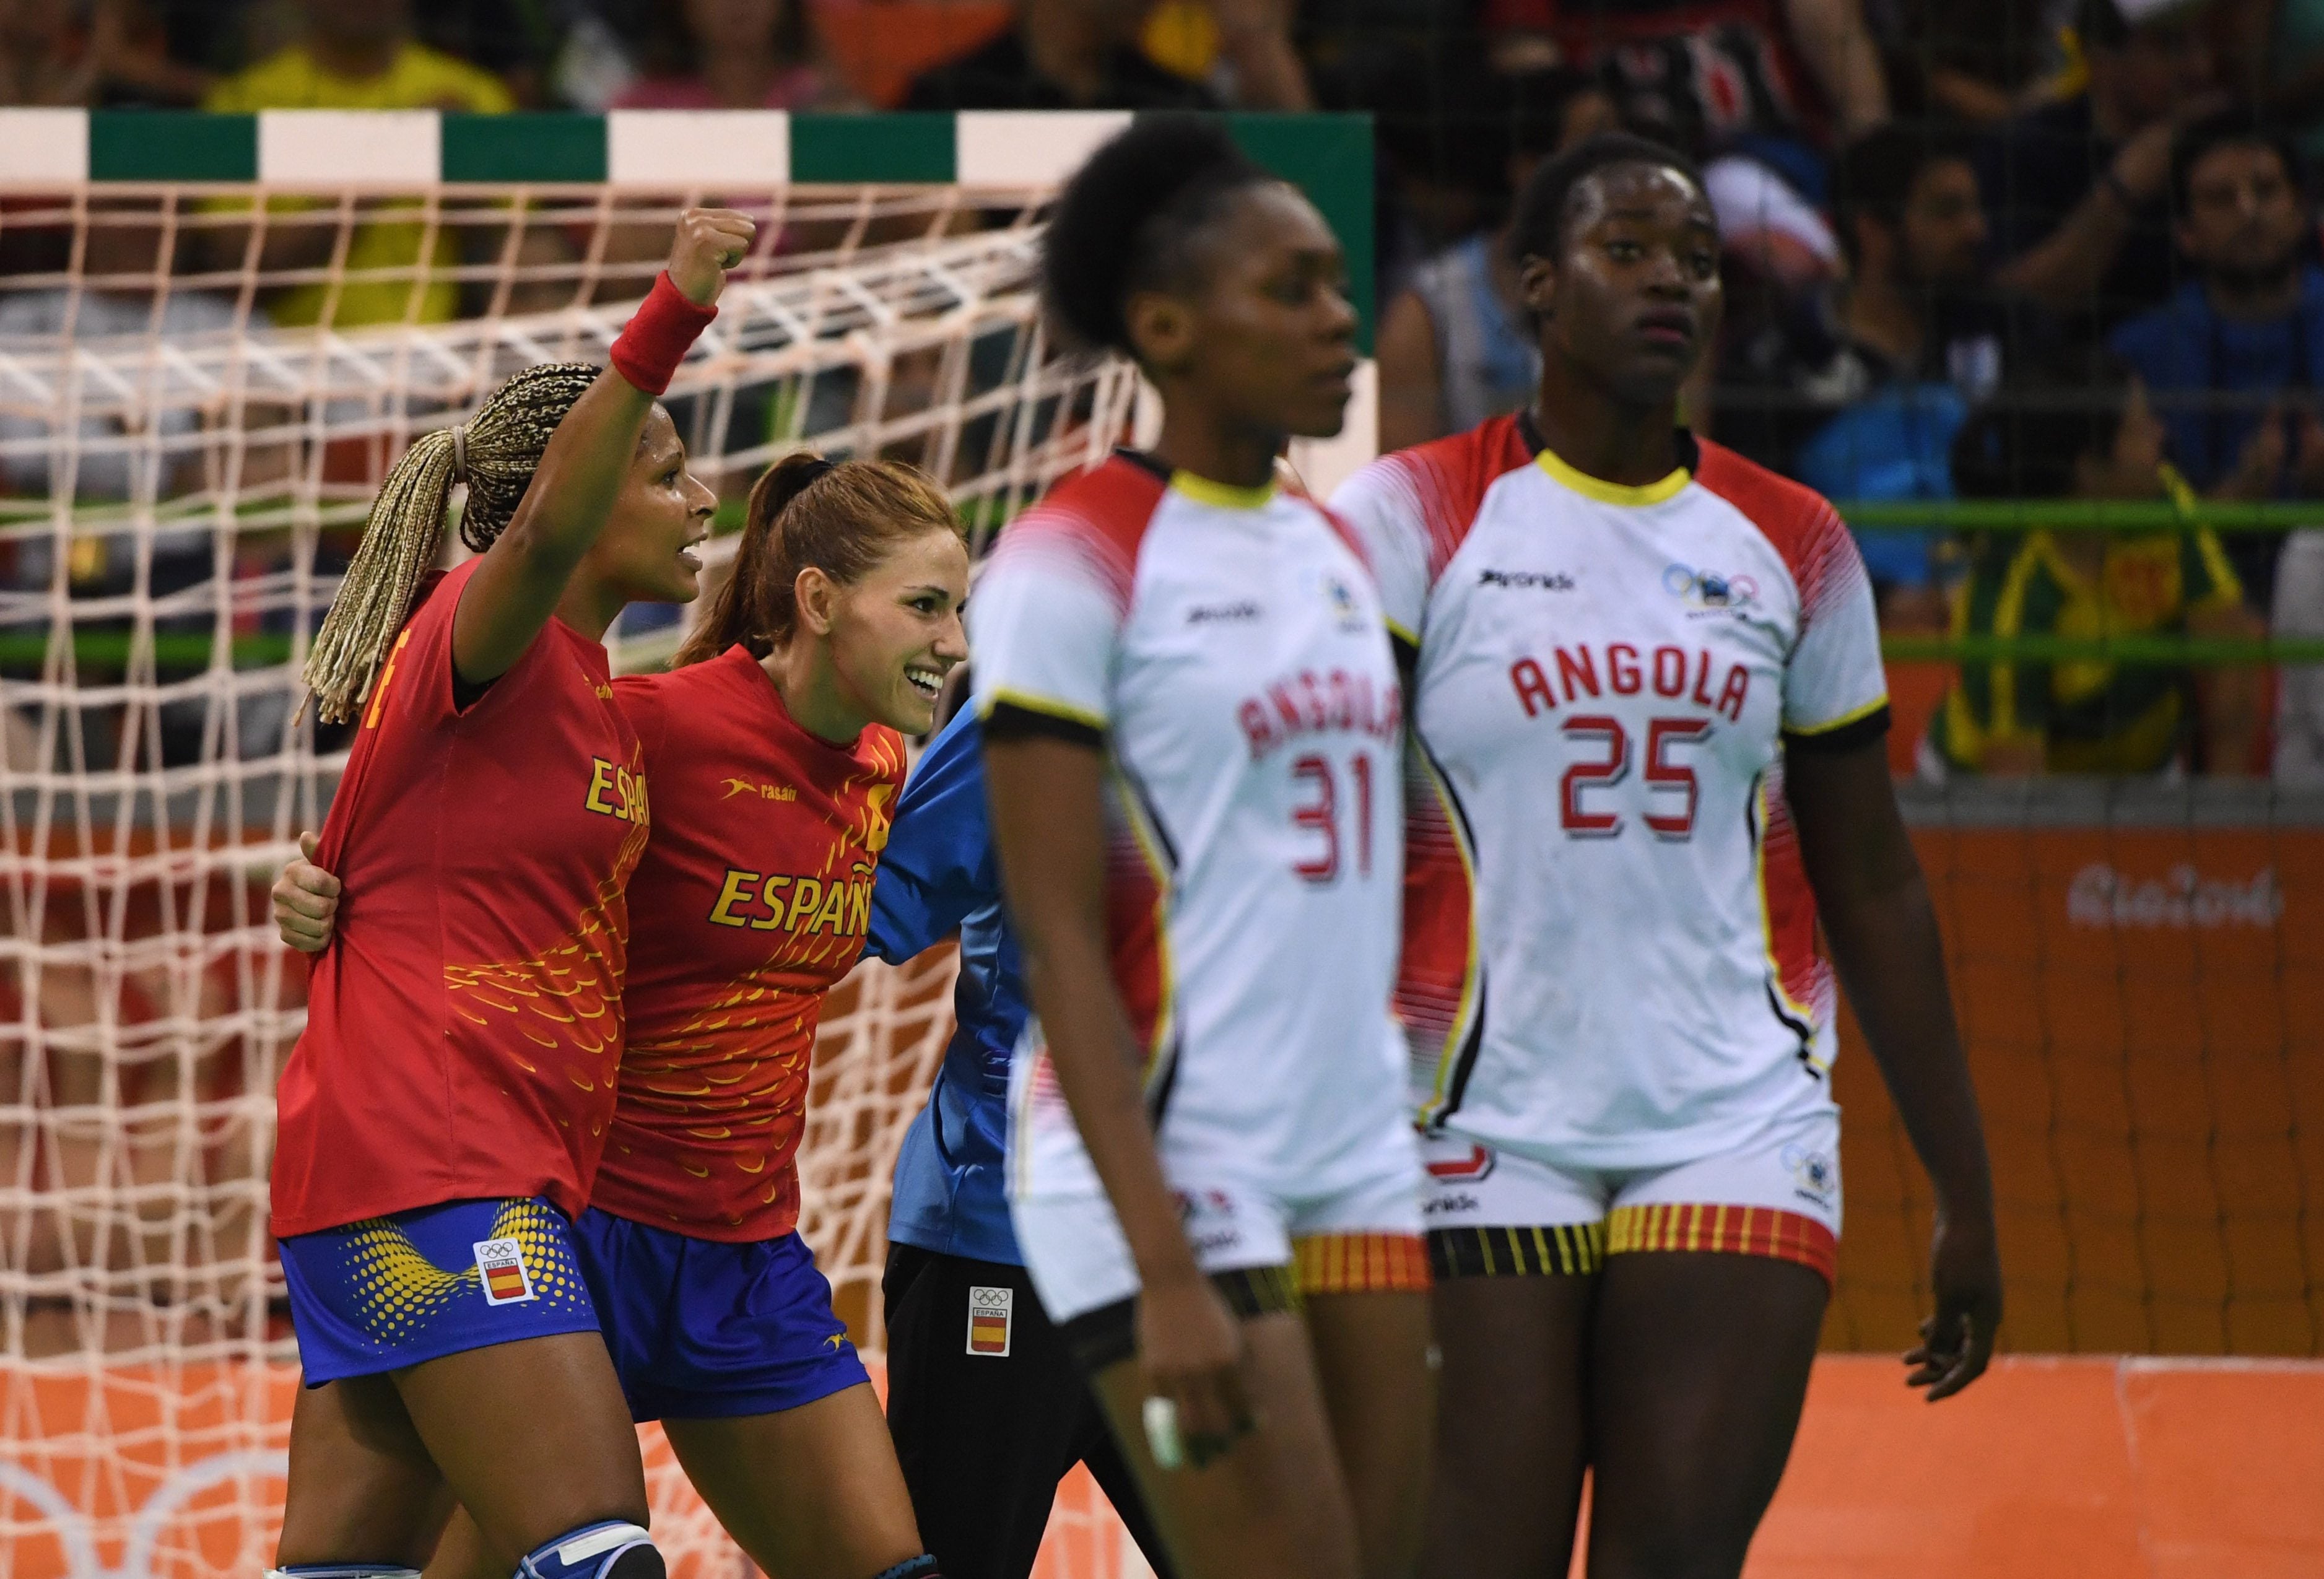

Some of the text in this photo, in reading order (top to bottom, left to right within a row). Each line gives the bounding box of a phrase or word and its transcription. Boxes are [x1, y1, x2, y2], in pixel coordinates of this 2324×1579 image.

[1510, 642, 1750, 723] ANGOLA
[1292, 749, 1373, 883] 31
[1560, 715, 1715, 841] 25
[708, 861, 873, 936] ESPAÑ
[487, 1259, 515, 1269] ESPAÑA
